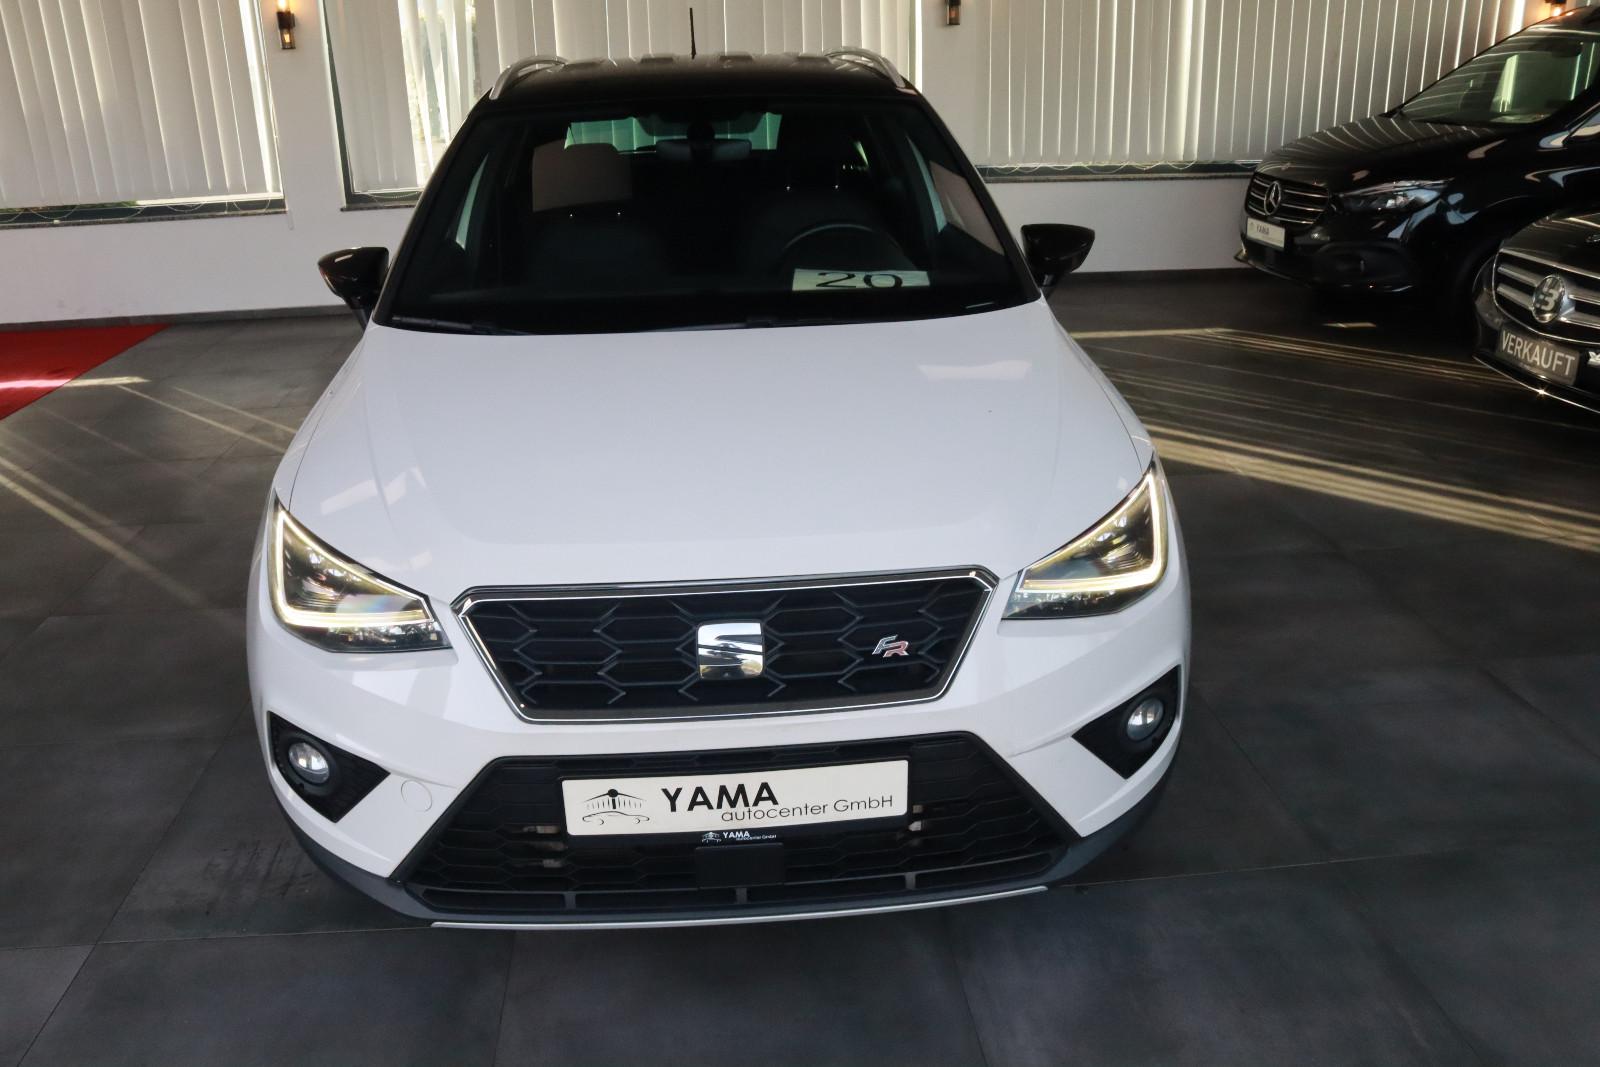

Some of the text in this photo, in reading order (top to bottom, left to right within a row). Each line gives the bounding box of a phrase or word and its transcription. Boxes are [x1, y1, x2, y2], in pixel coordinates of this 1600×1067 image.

[1502, 330, 1576, 375] VERKAUFT
[872, 634, 909, 658] FR
[661, 781, 779, 813] YAMA
[721, 795, 893, 822] autocenter GmbH
[723, 830, 751, 839] YAMA
